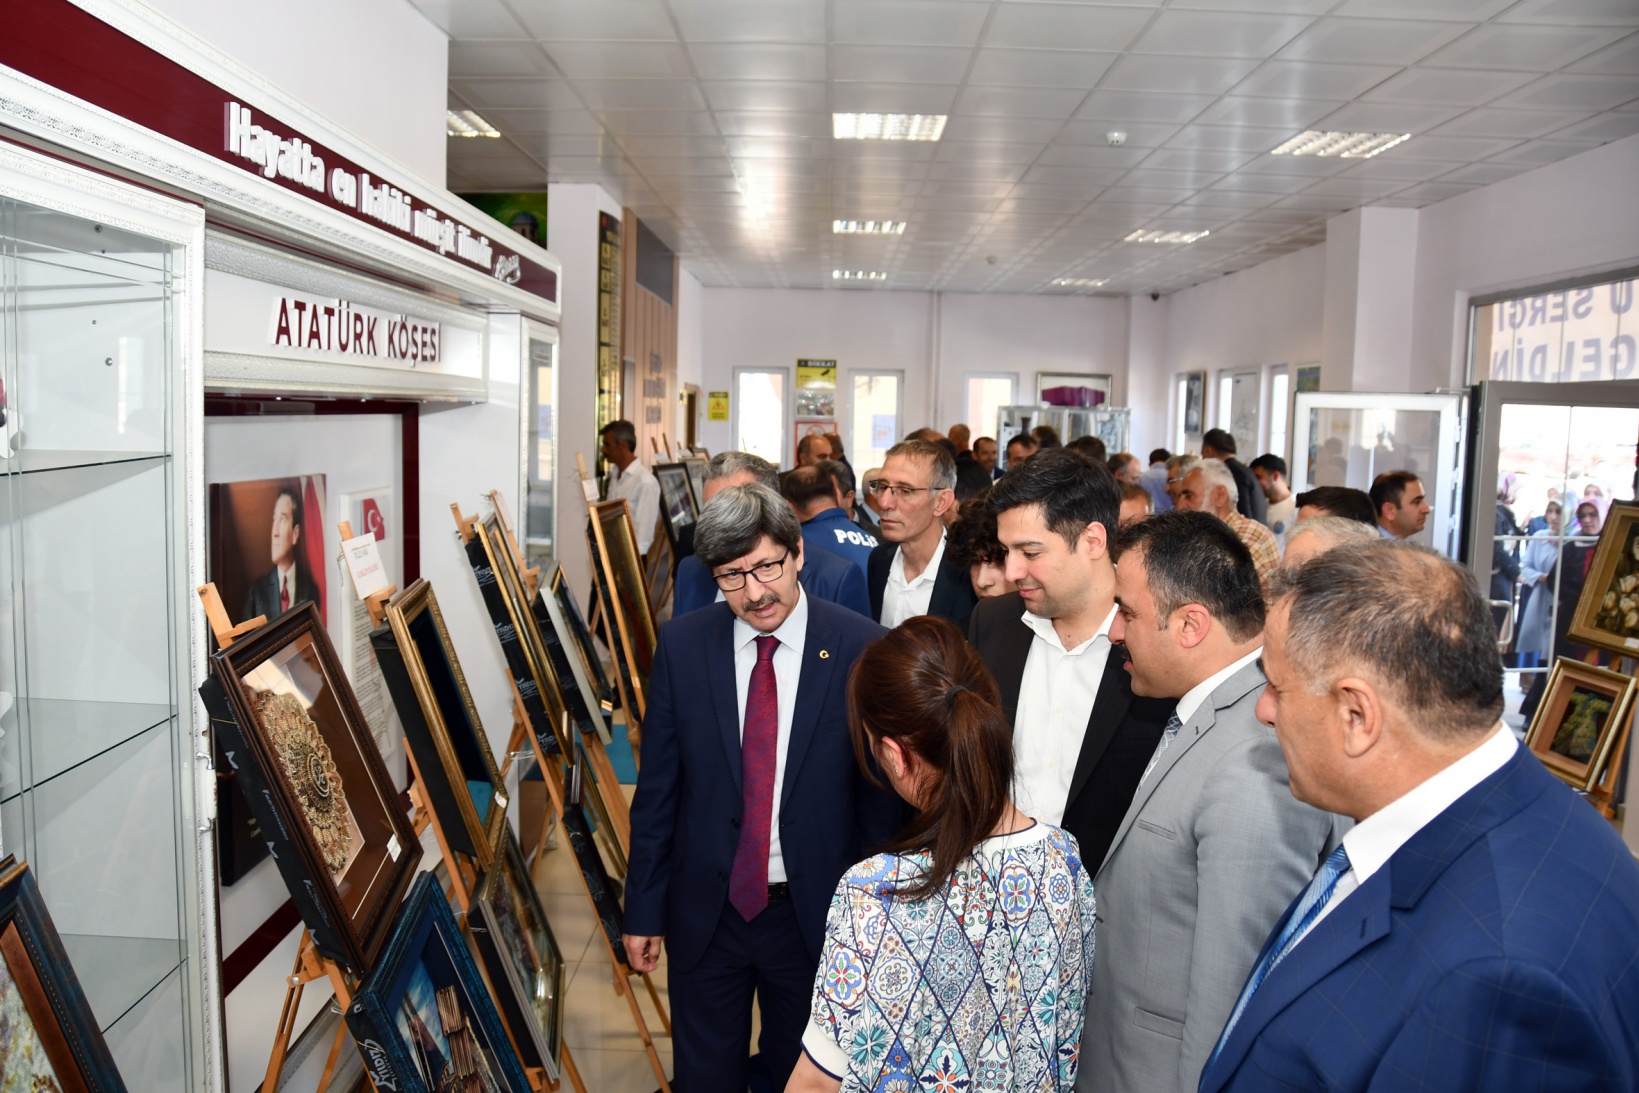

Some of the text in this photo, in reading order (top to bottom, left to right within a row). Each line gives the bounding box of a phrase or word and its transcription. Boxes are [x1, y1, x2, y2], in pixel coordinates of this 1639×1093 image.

[226, 101, 325, 193] Hayatta
[330, 168, 357, 208] en
[360, 173, 412, 233] hakiki
[274, 298, 441, 367] ATATÜRK KÖŞESİ
[833, 529, 879, 548] POLİS
